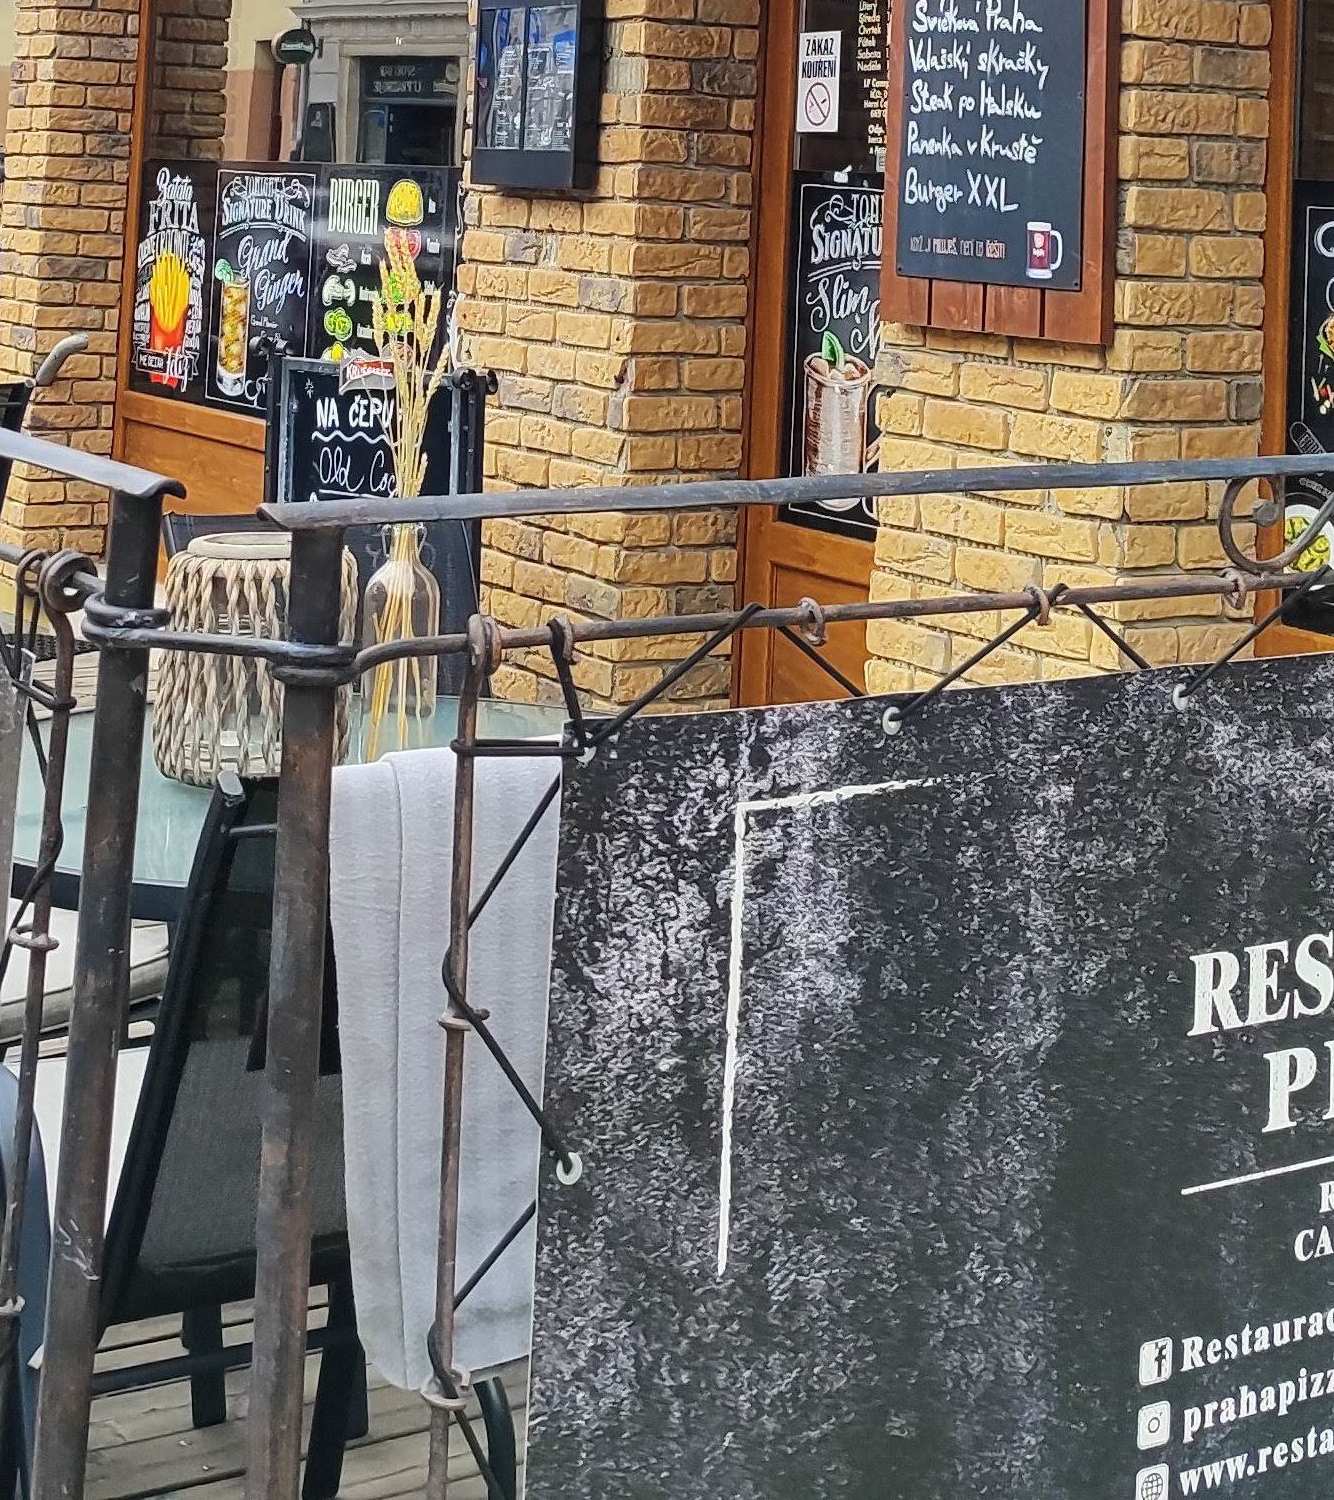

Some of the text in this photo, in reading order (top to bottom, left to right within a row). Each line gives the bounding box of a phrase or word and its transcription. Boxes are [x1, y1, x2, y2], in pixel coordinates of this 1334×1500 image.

[805, 35, 834, 57] ZÁKAZ
[801, 55, 837, 79] KOUŘENÍ
[910, 79, 954, 114] Steak
[958, 95, 976, 119] po
[907, 121, 963, 160] Panenka
[328, 178, 380, 236] BURGER
[904, 167, 1020, 214] Burger XXL
[147, 200, 200, 236] FRITA
[222, 196, 307, 236] SIGNATURE DRINK
[238, 231, 293, 280] Grand
[255, 268, 306, 315] Ginger
[317, 393, 395, 428] NA ČEPU
[319, 446, 365, 492] Old
